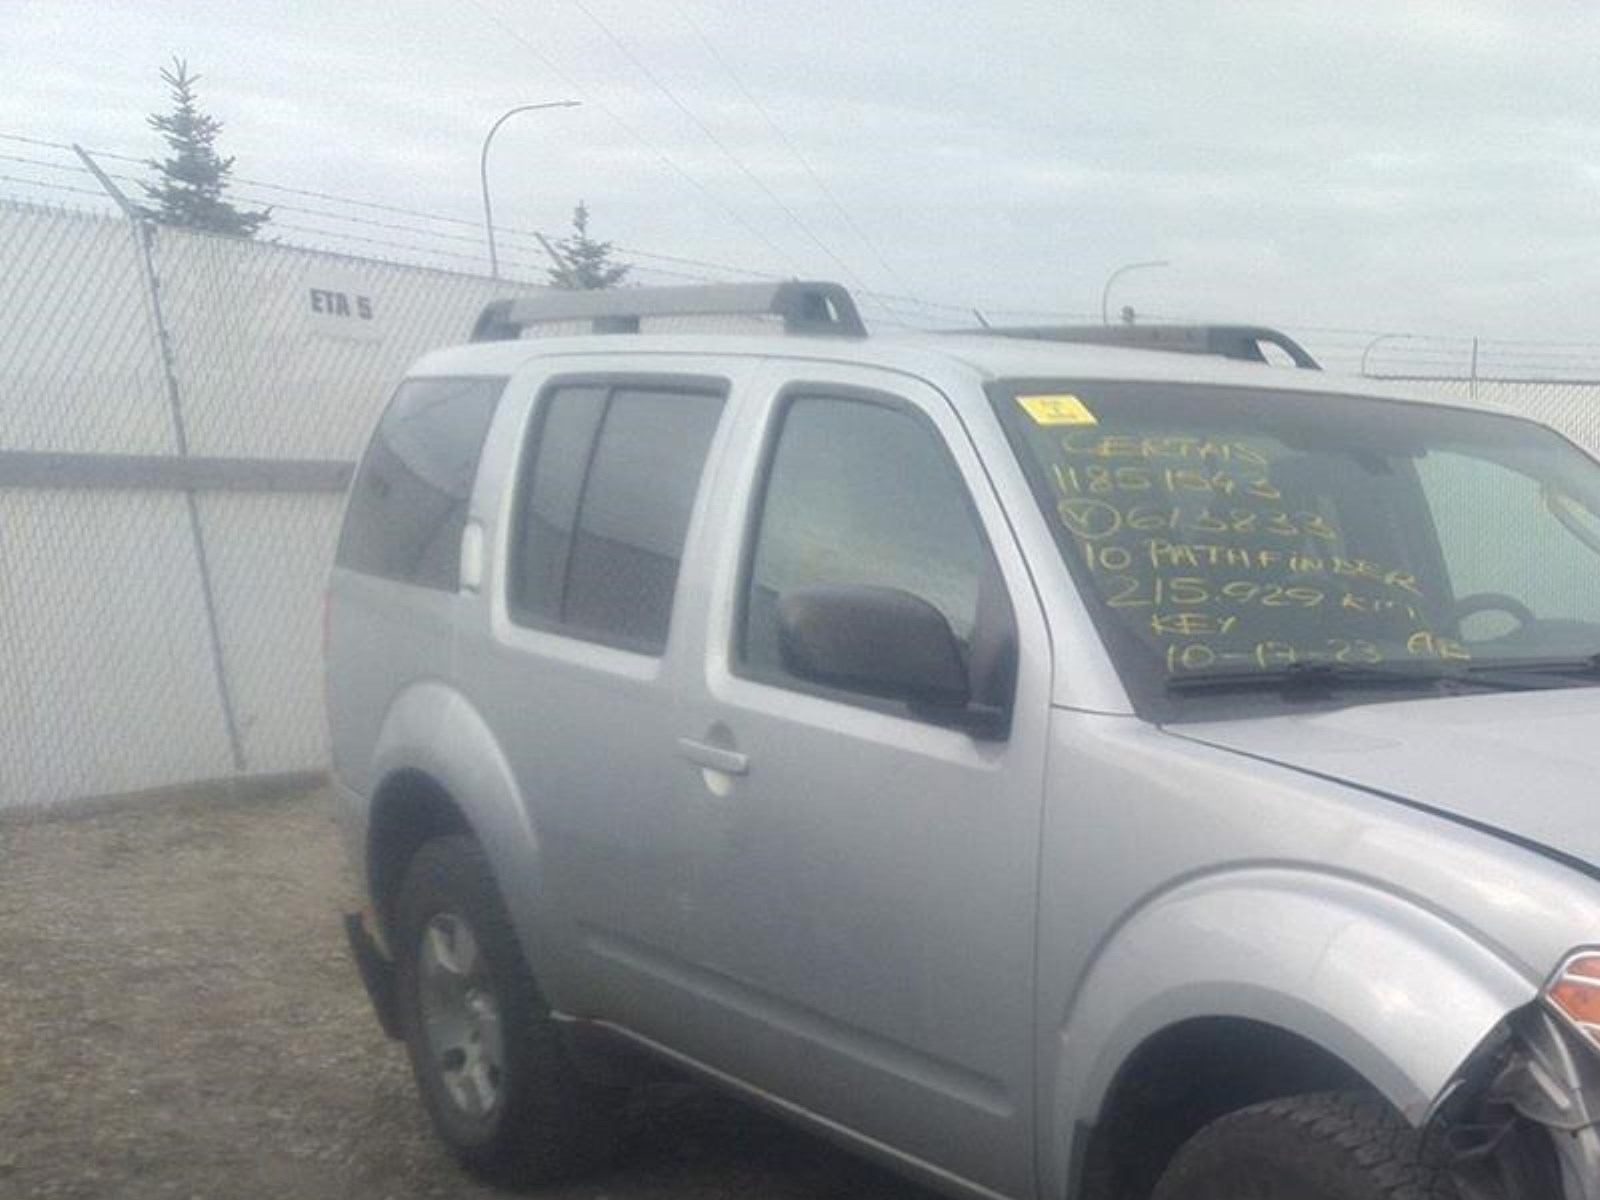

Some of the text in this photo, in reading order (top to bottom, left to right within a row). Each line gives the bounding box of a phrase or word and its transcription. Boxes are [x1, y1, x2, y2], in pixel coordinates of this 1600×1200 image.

[309, 287, 374, 320] ETA 5
[1053, 463, 1281, 499] 11851543
[1086, 538, 1424, 597] 10 PATHFINDER
[1150, 612, 1237, 636] KEY
